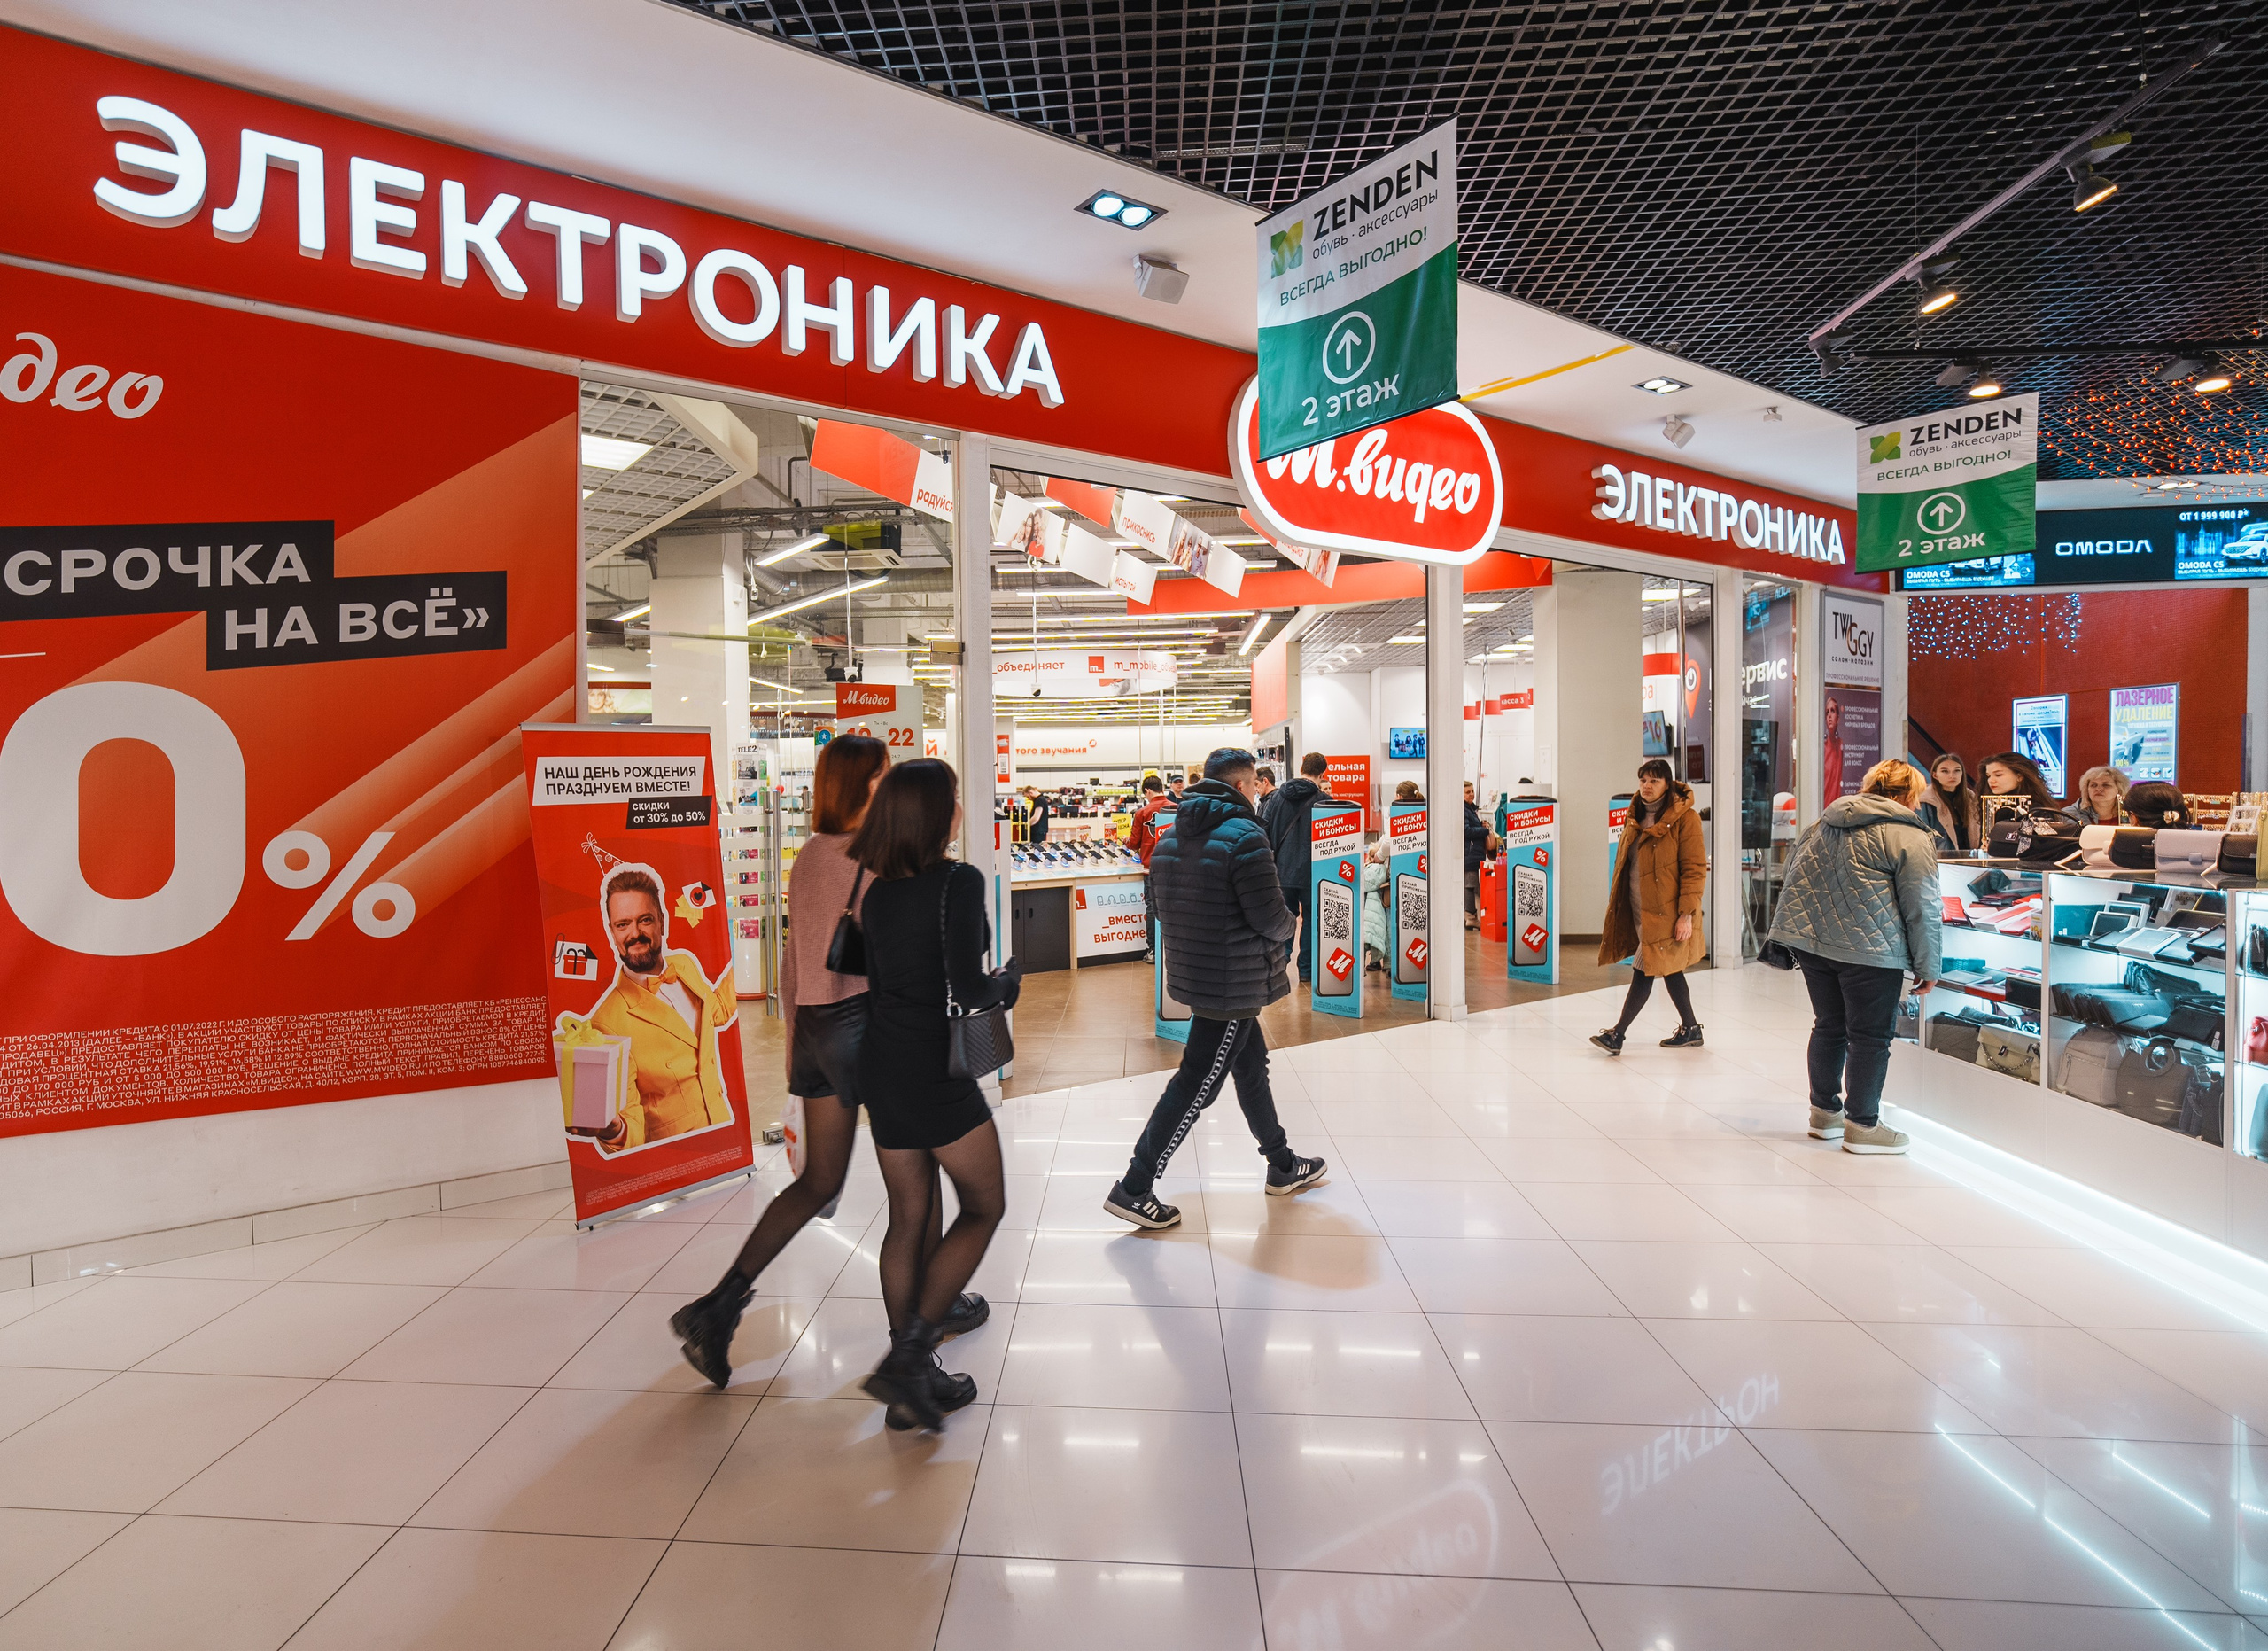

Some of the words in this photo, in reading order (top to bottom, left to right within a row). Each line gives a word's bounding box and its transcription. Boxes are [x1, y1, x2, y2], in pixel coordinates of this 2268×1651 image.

[1313, 150, 1439, 241] ZENDEN
[1312, 234, 1348, 260] обувь
[1358, 189, 1439, 238] аксессуары
[93, 95, 1065, 409] ЭЛЕКТРОНИКА
[1280, 270, 1335, 306] ВСЕГДА
[1339, 226, 1428, 278] ВЫГОДНО!
[1302, 396, 1318, 426] 2
[1326, 374, 1400, 418] этаж
[1909, 408, 2023, 446] ZENDEN
[1909, 444, 1943, 458] обувь
[1951, 430, 2023, 450] аксессуары
[1876, 464, 1930, 481] ВСЕГДА
[1934, 449, 2012, 471] ВЫГОДНО!
[1591, 464, 1846, 565] ЭЛЕКТРОНИКА
[2201, 510, 2218, 520] 999
[2218, 510, 2236, 520] 900
[1122, 517, 1156, 544] прикоснись
[1898, 539, 1913, 557] 2
[1920, 533, 1985, 554] этаж
[2055, 540, 2153, 556] OMODA
[4, 543, 311, 596] СРОЧКА
[1907, 570, 1938, 579] OMODA
[225, 605, 318, 650] НА
[338, 587, 489, 642] ВСЁ»
[843, 690, 890, 705] М.видео
[2115, 687, 2174, 707] ЛАЗЕРНОЕ
[2115, 705, 2173, 723] УДАЛЕНИЕ
[888, 728, 915, 747] 22
[1040, 747, 1087, 756] звучания
[544, 767, 579, 779] НАШ
[583, 767, 620, 780] ДЕНЬ
[624, 766, 696, 780] РОЖДЕНИЯ
[1327, 774, 1365, 784] товара
[546, 781, 632, 797] ПРАЗДНУЕМ
[635, 781, 690, 793] ВМЕСТЕ!
[633, 814, 645, 824] от
[647, 813, 669, 823] 30%
[671, 813, 684, 823] до
[686, 811, 705, 822] 50%
[1315, 817, 1344, 829] СКИДКИ
[1393, 814, 1422, 826] СКИДКИ
[1509, 810, 1538, 821] СКИДКИ
[1520, 814, 1550, 826] БОНУСЫ
[1325, 823, 1356, 836] БОНУСЫ
[1404, 821, 1426, 832] БОНУС
[1509, 829, 1534, 838] ВСЕГДА
[1314, 840, 1339, 850] ВСЕГДА
[1393, 835, 1417, 845] ВСЕГДА
[1528, 833, 1550, 842] РУКОЙ
[1334, 843, 1356, 854] РУКОЙ
[4, 1035, 27, 1044] ПРИ
[28, 1029, 110, 1041] ОФОРМЛЕНИИ
[112, 1024, 160, 1036] КРЕДИТА
[170, 1020, 217, 1031] 01.07.2022
[250, 1015, 296, 1024] ОСОБОГО
[298, 1009, 375, 1021] РАСПОРЯЖЕНИЯ.
[376, 1006, 410, 1016] КРЕДИТ
[412, 1001, 483, 1013] ПРЕДОСТАВЛЯЕТ
[26, 1039, 79, 1050] 26.04.2013
[82, 1036, 122, 1047] (ДАЛЕЕ
[133, 1032, 175, 1041] «БАНК»).
[186, 1028, 221, 1039] АКЦИИ
[223, 1023, 283, 1034] УЧАСТВУЮТ
[284, 1020, 323, 1029] ТОВАРЫ
[340, 1016, 377, 1024] СПИСКУ.
[387, 1012, 422, 1021] РАМКАХ
[424, 1009, 453, 1019] АКЦИИ
[478, 1002, 546, 1015] ПРЕДОСТАВЛЯЕТ
[35, 1103, 84, 1117] РОССИЯ,
[96, 1097, 144, 1110] МОСКВА,
[164, 1091, 208, 1102] НИЖНЯЯ
[211, 1081, 303, 1098] КРАСНОСЕЛЬСКАЯ,
[315, 1078, 340, 1087] 40/12,
[342, 1075, 368, 1084] КОРП.
[489, 1056, 546, 1068] 1057746840095.
